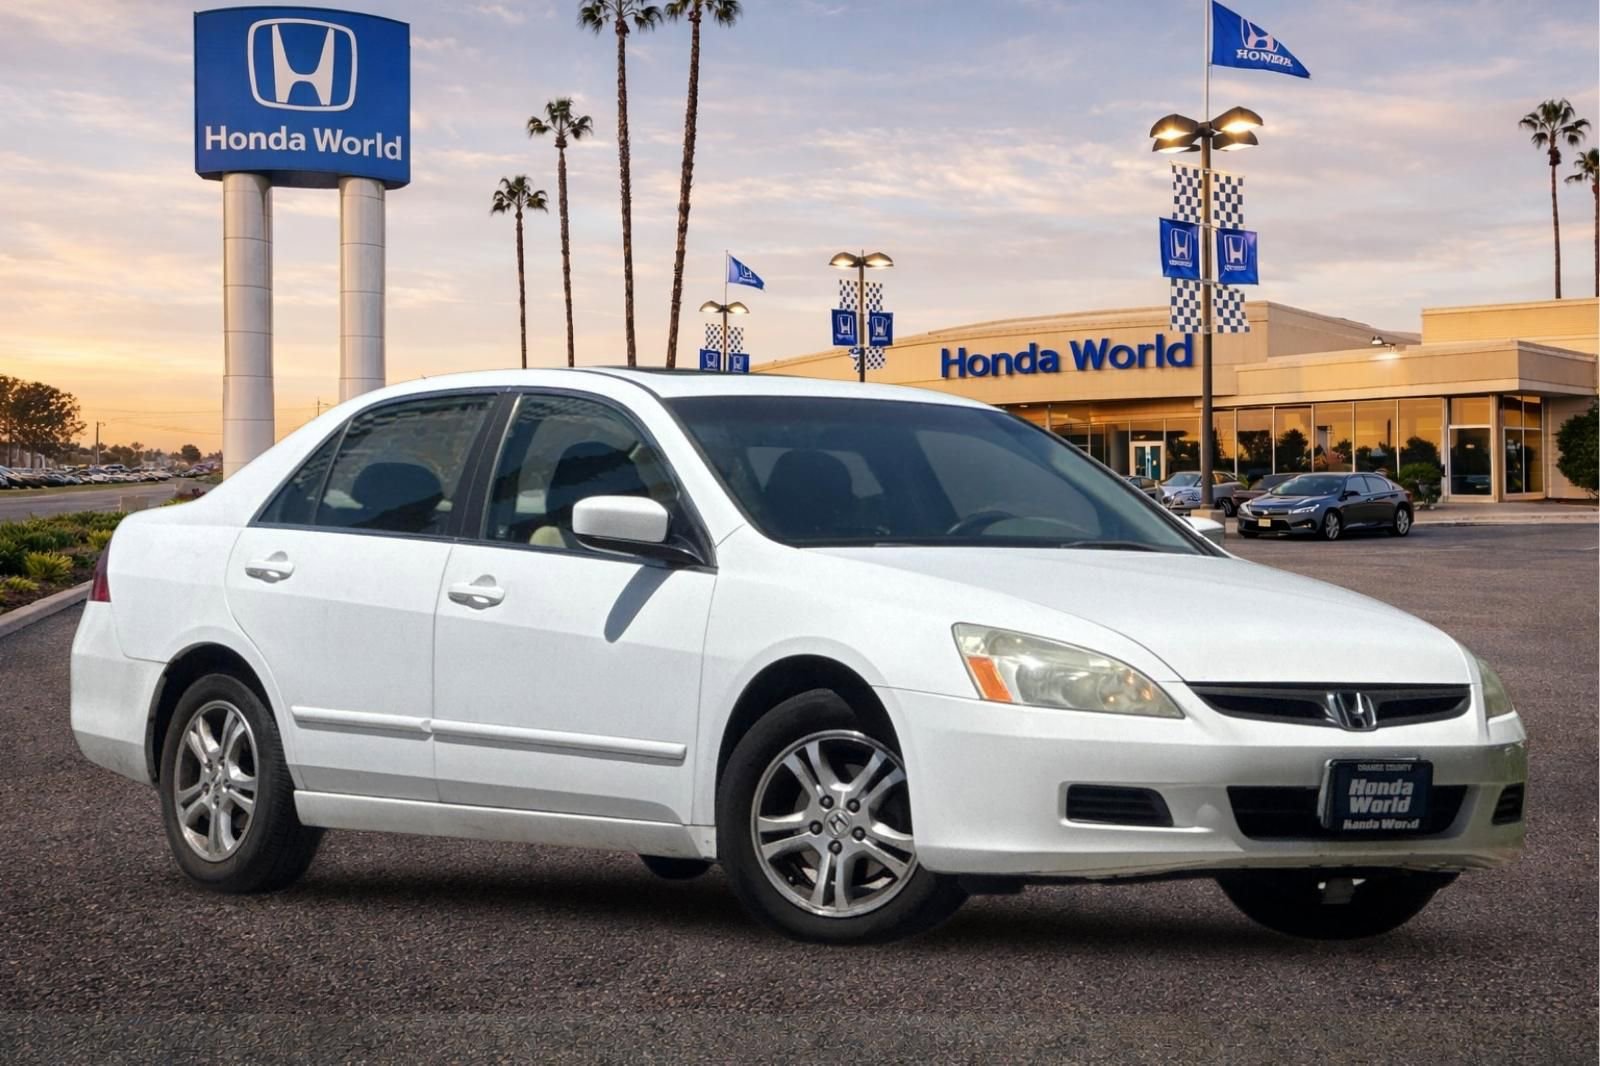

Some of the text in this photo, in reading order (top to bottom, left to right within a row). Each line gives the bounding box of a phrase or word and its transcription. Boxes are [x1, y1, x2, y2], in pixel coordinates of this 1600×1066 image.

[205, 125, 402, 160] Honda World
[941, 333, 1193, 378] Honda World
[1349, 778, 1414, 795] Honda
[1350, 797, 1411, 813] World
